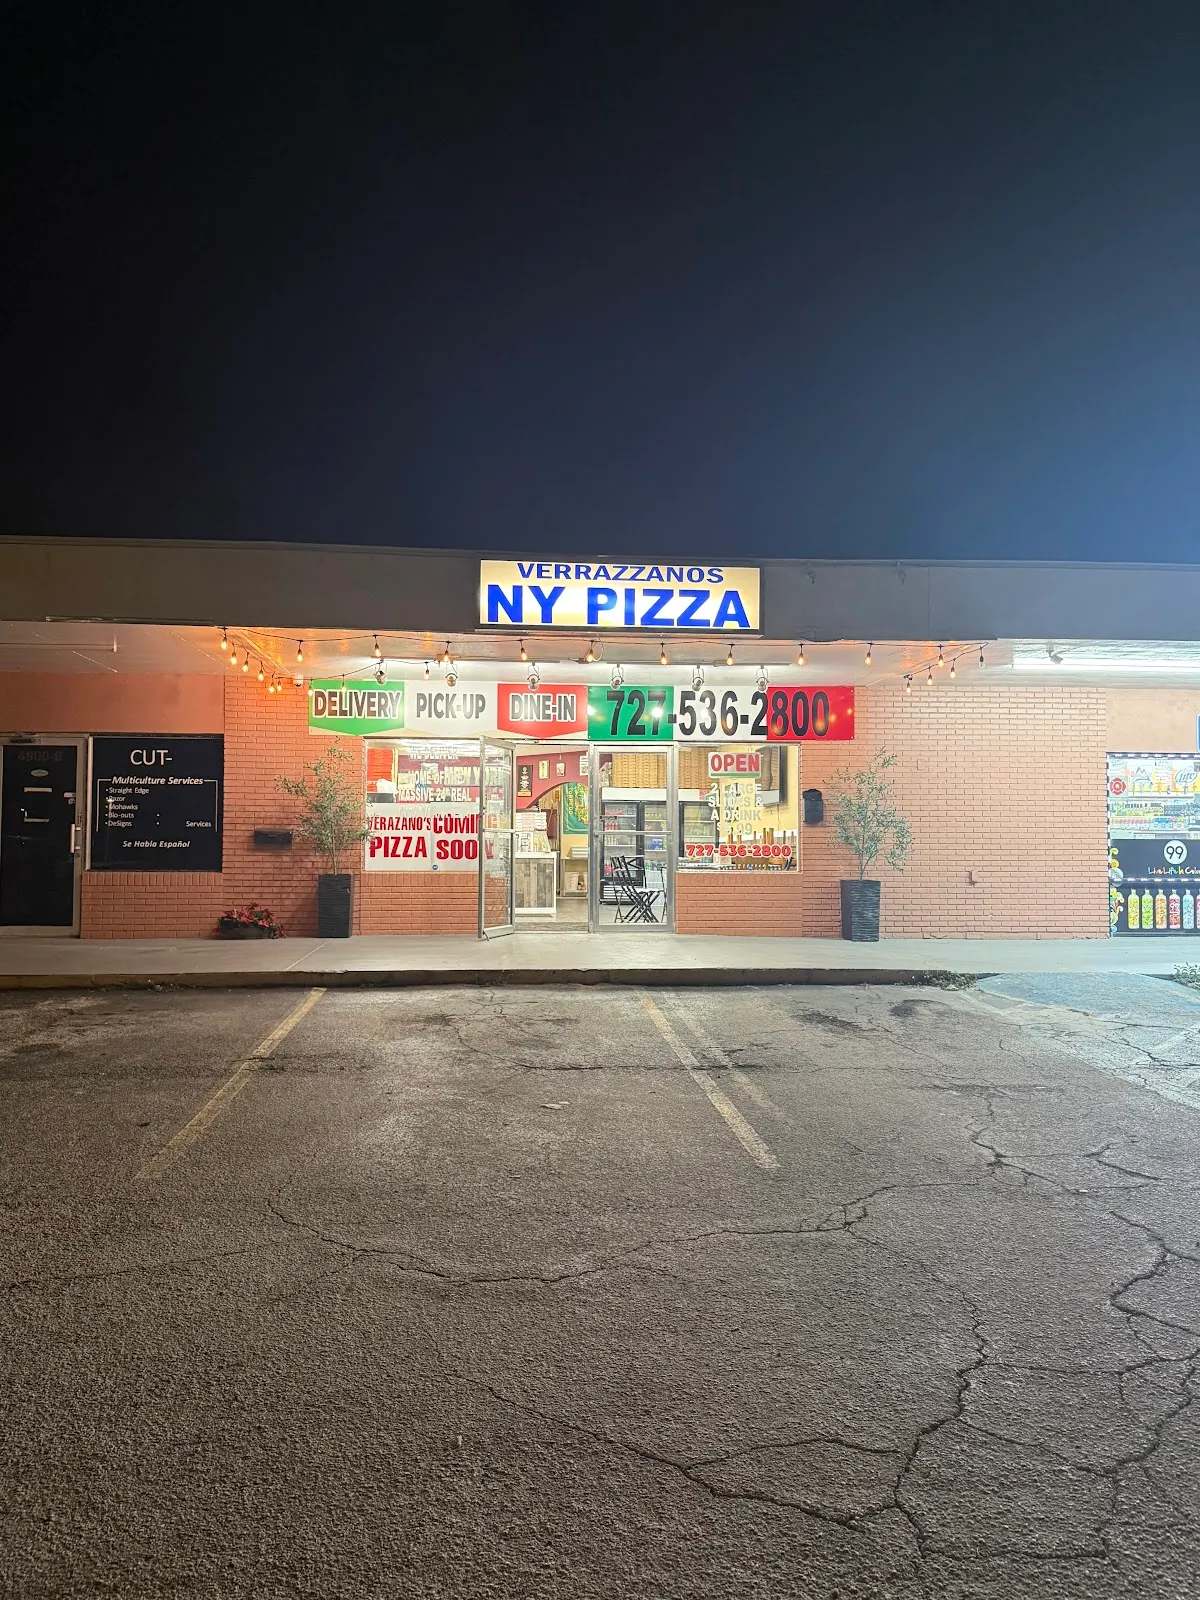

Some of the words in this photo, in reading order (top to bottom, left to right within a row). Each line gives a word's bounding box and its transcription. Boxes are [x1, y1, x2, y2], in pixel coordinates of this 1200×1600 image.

[517, 563, 724, 583] VERRAZZANOS
[487, 585, 566, 624] NY
[587, 587, 751, 628] PIZZA
[314, 690, 401, 718] DELIVERY
[416, 693, 486, 719] PICK-UP
[511, 694, 576, 721] DINE-IN
[606, 690, 830, 736] 727-536-2800
[130, 750, 173, 766] CUT-
[710, 754, 760, 772] OPEN
[112, 776, 165, 785] Multiculture
[167, 776, 204, 785] Services
[109, 787, 132, 795] Straight
[134, 787, 150, 795] Edge
[451, 787, 472, 801] REAL
[725, 809, 761, 822] DRINK
[159, 841, 191, 849] Español
[369, 836, 428, 858] PIZZA
[685, 844, 792, 858] 727-536-2800
[1166, 845, 1184, 860] 99
